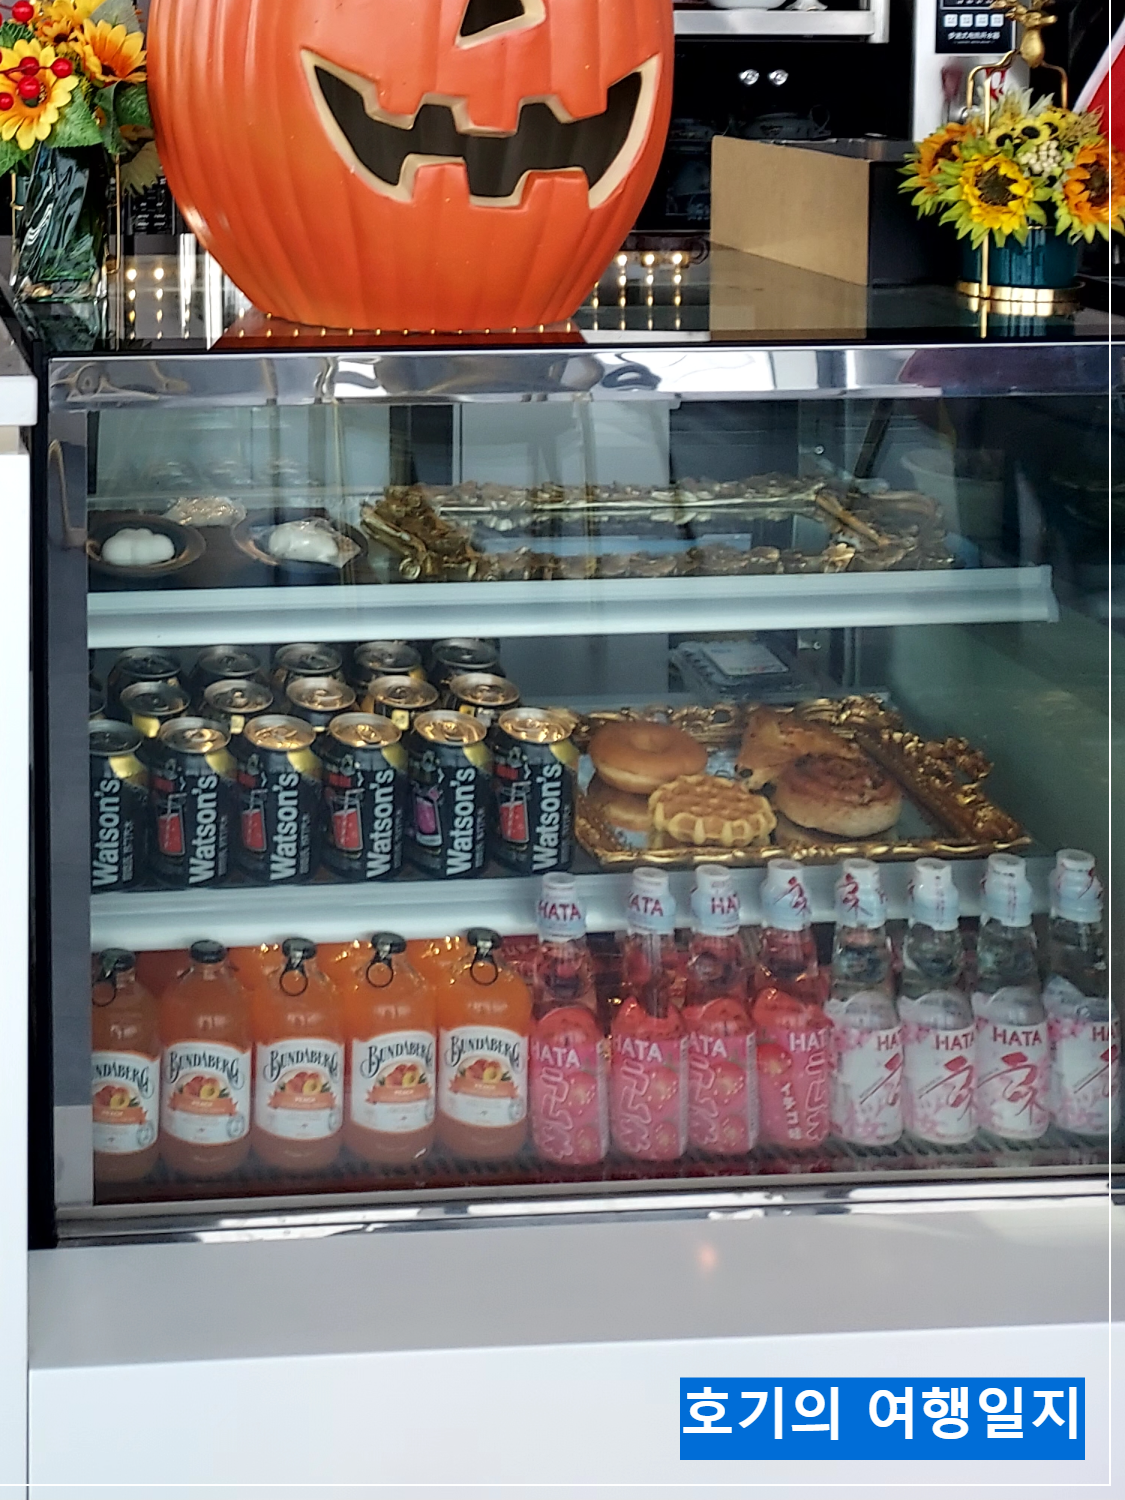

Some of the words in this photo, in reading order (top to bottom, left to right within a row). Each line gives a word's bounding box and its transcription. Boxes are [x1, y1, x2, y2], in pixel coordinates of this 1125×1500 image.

[92, 777, 120, 887] Watson's
[188, 774, 218, 884] Watson's
[269, 772, 299, 881] Watson's
[366, 768, 394, 878] Watson's
[446, 766, 475, 876] Watson's
[532, 762, 562, 871] Watson's
[538, 900, 581, 921] HATA
[711, 893, 740, 915] HA
[444, 1035, 524, 1074] BUNDABERG
[688, 1031, 727, 1058] ATA
[877, 1028, 901, 1051] HA
[993, 1027, 1042, 1046] HATA
[94, 1062, 154, 1098] NDABERG
[168, 1051, 244, 1090] BUNDABERG
[263, 1048, 339, 1083] BUNDABERG
